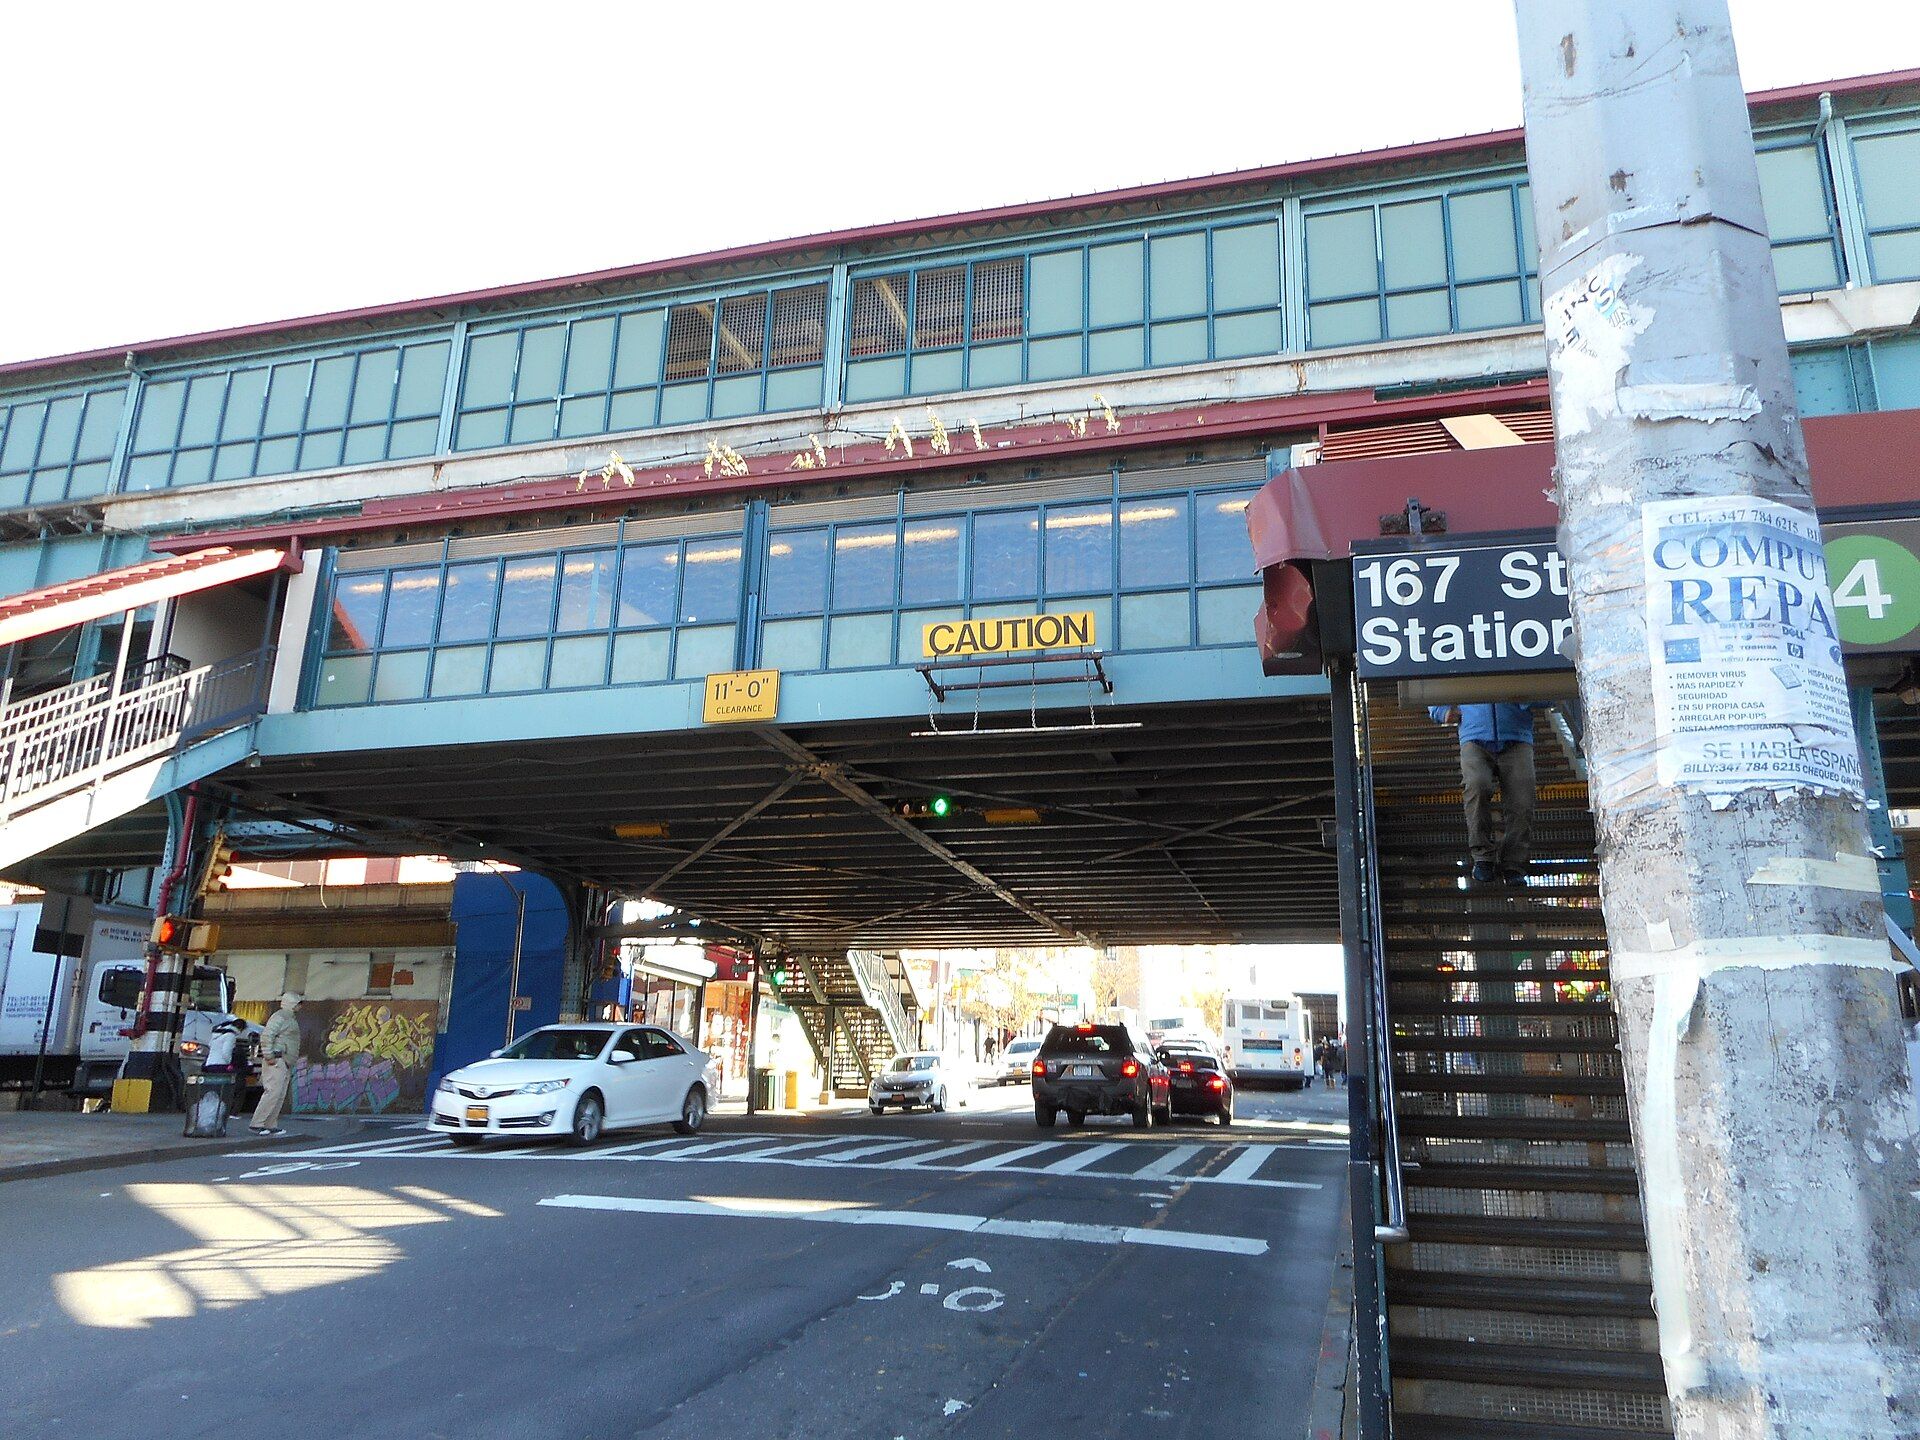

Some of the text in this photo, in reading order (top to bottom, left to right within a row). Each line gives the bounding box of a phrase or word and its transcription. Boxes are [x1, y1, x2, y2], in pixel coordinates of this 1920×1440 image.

[1668, 511, 1713, 525] CEL:
[1718, 509, 1746, 522] 347
[1751, 510, 1772, 524] 784
[1775, 517, 1799, 532] 6215
[1358, 550, 1568, 608] 167 St
[1832, 558, 1892, 619] 4
[1664, 575, 1837, 641] REPA
[928, 613, 1089, 656] CAUTION
[1676, 670, 1747, 681] REMOVER VIRUS
[1677, 680, 1745, 691] MAS RAPIDEZ Y
[1677, 691, 1729, 701] SEGURIDAD
[716, 704, 763, 715] CLEARANCE
[1678, 701, 1766, 712] EN SU PROPIA CASA
[1678, 712, 1768, 723] ARREGLAR POP-UPS
[1702, 742, 1734, 760] SE
[1746, 762, 1769, 772] 784
[1772, 761, 1801, 773] 6215
[1802, 765, 1840, 782] CHEQUEO
